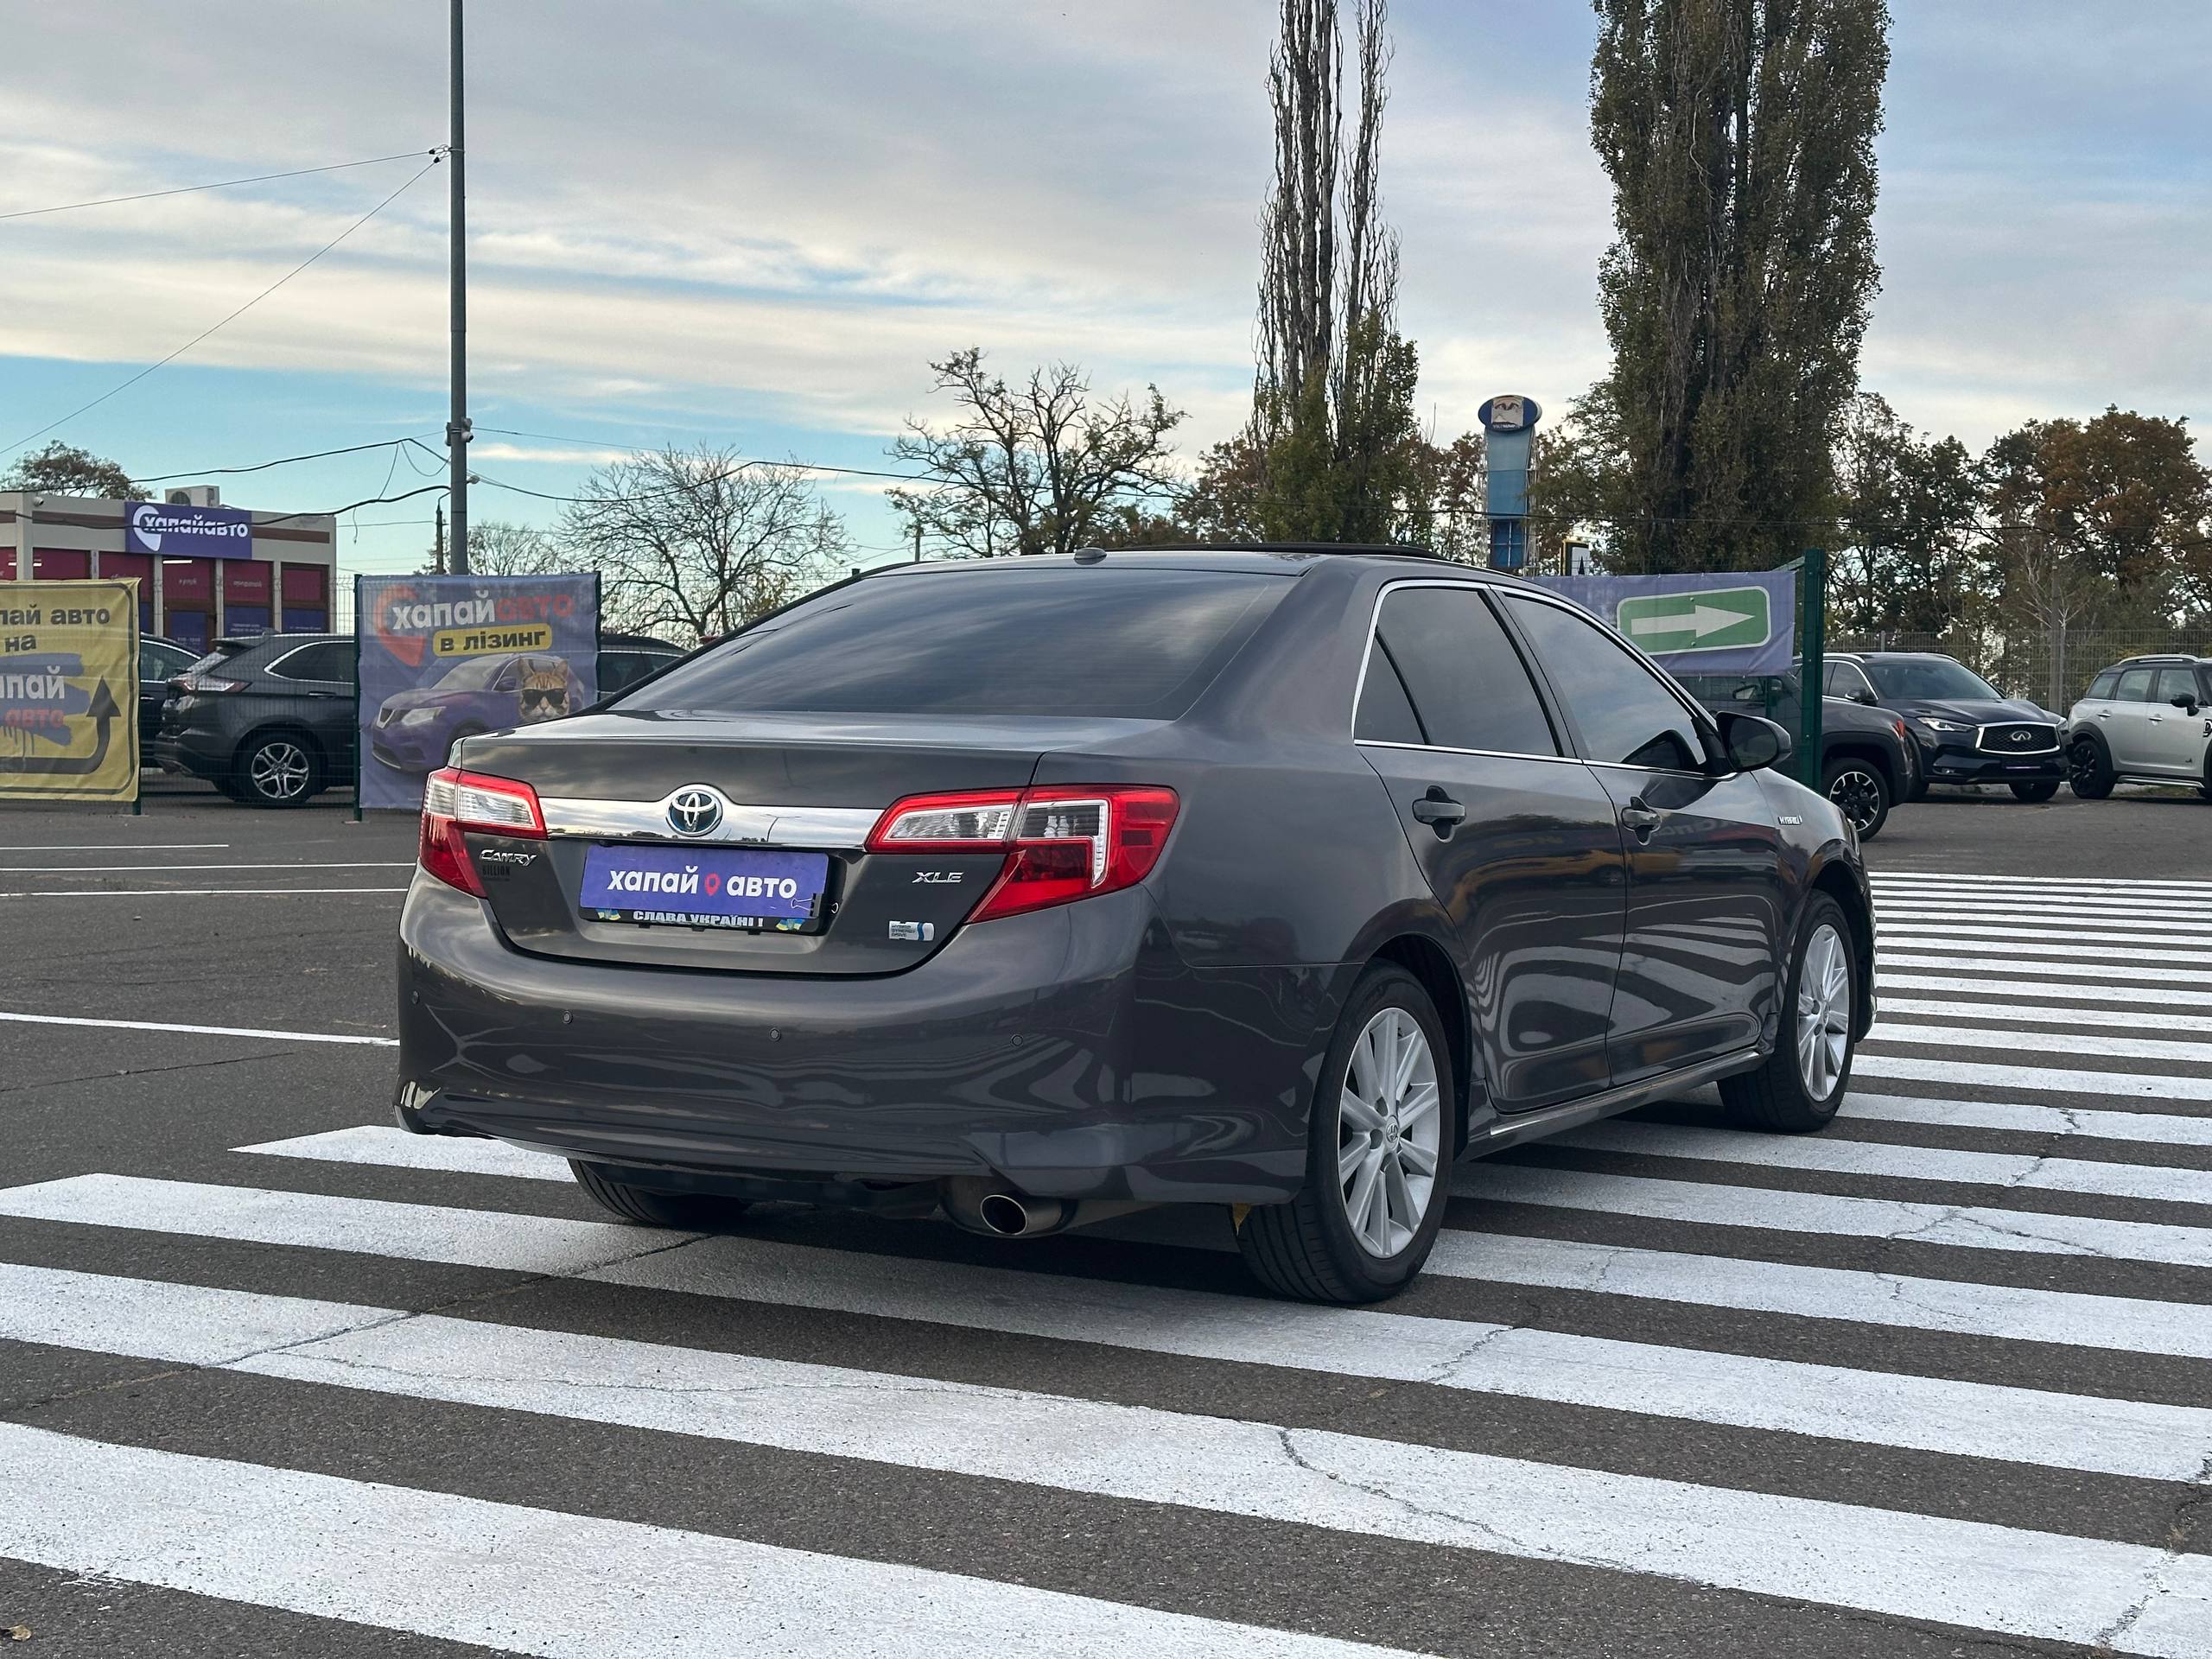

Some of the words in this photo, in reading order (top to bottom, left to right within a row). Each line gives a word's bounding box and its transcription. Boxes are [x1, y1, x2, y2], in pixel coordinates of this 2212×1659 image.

[50, 608, 111, 625] авто
[4, 634, 37, 652] на
[440, 637, 454, 652] в
[463, 629, 546, 651] лізинг
[0, 665, 65, 700] пай
[5, 709, 65, 728] авто
[607, 865, 698, 894] хапай
[726, 875, 798, 899] авто
[912, 871, 964, 883] XLE
[632, 910, 687, 924] СЛАВА
